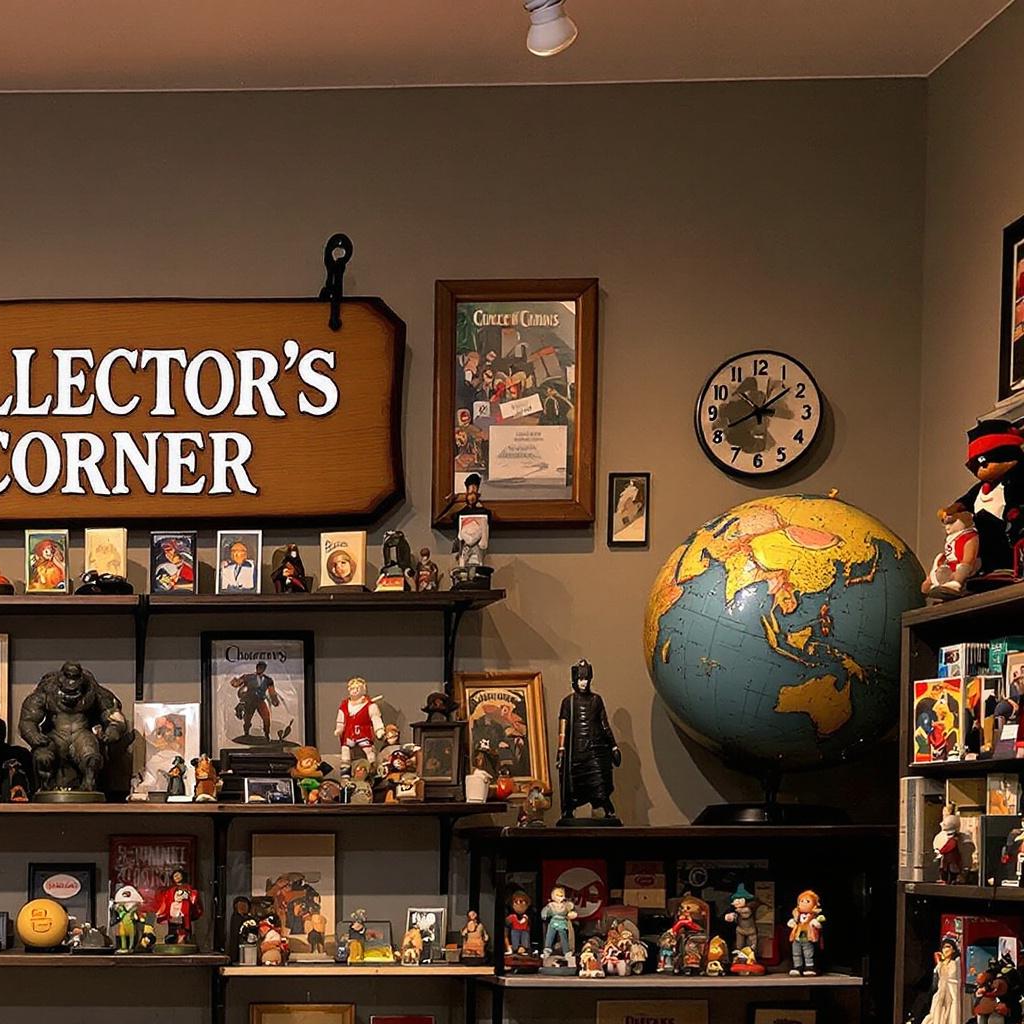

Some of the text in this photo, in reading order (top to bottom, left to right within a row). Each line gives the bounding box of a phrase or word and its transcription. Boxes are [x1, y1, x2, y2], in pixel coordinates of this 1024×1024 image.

[731, 366, 742, 382] 11
[753, 359, 768, 376] 12
[714, 384, 729, 401] 10
[795, 382, 806, 398] 2
[708, 405, 718, 421] 9
[801, 404, 812, 420] 3
[712, 429, 723, 444] 8
[793, 428, 804, 444] 4
[730, 446, 742, 463] 7
[753, 453, 763, 468] 6
[776, 446, 787, 462] 5
